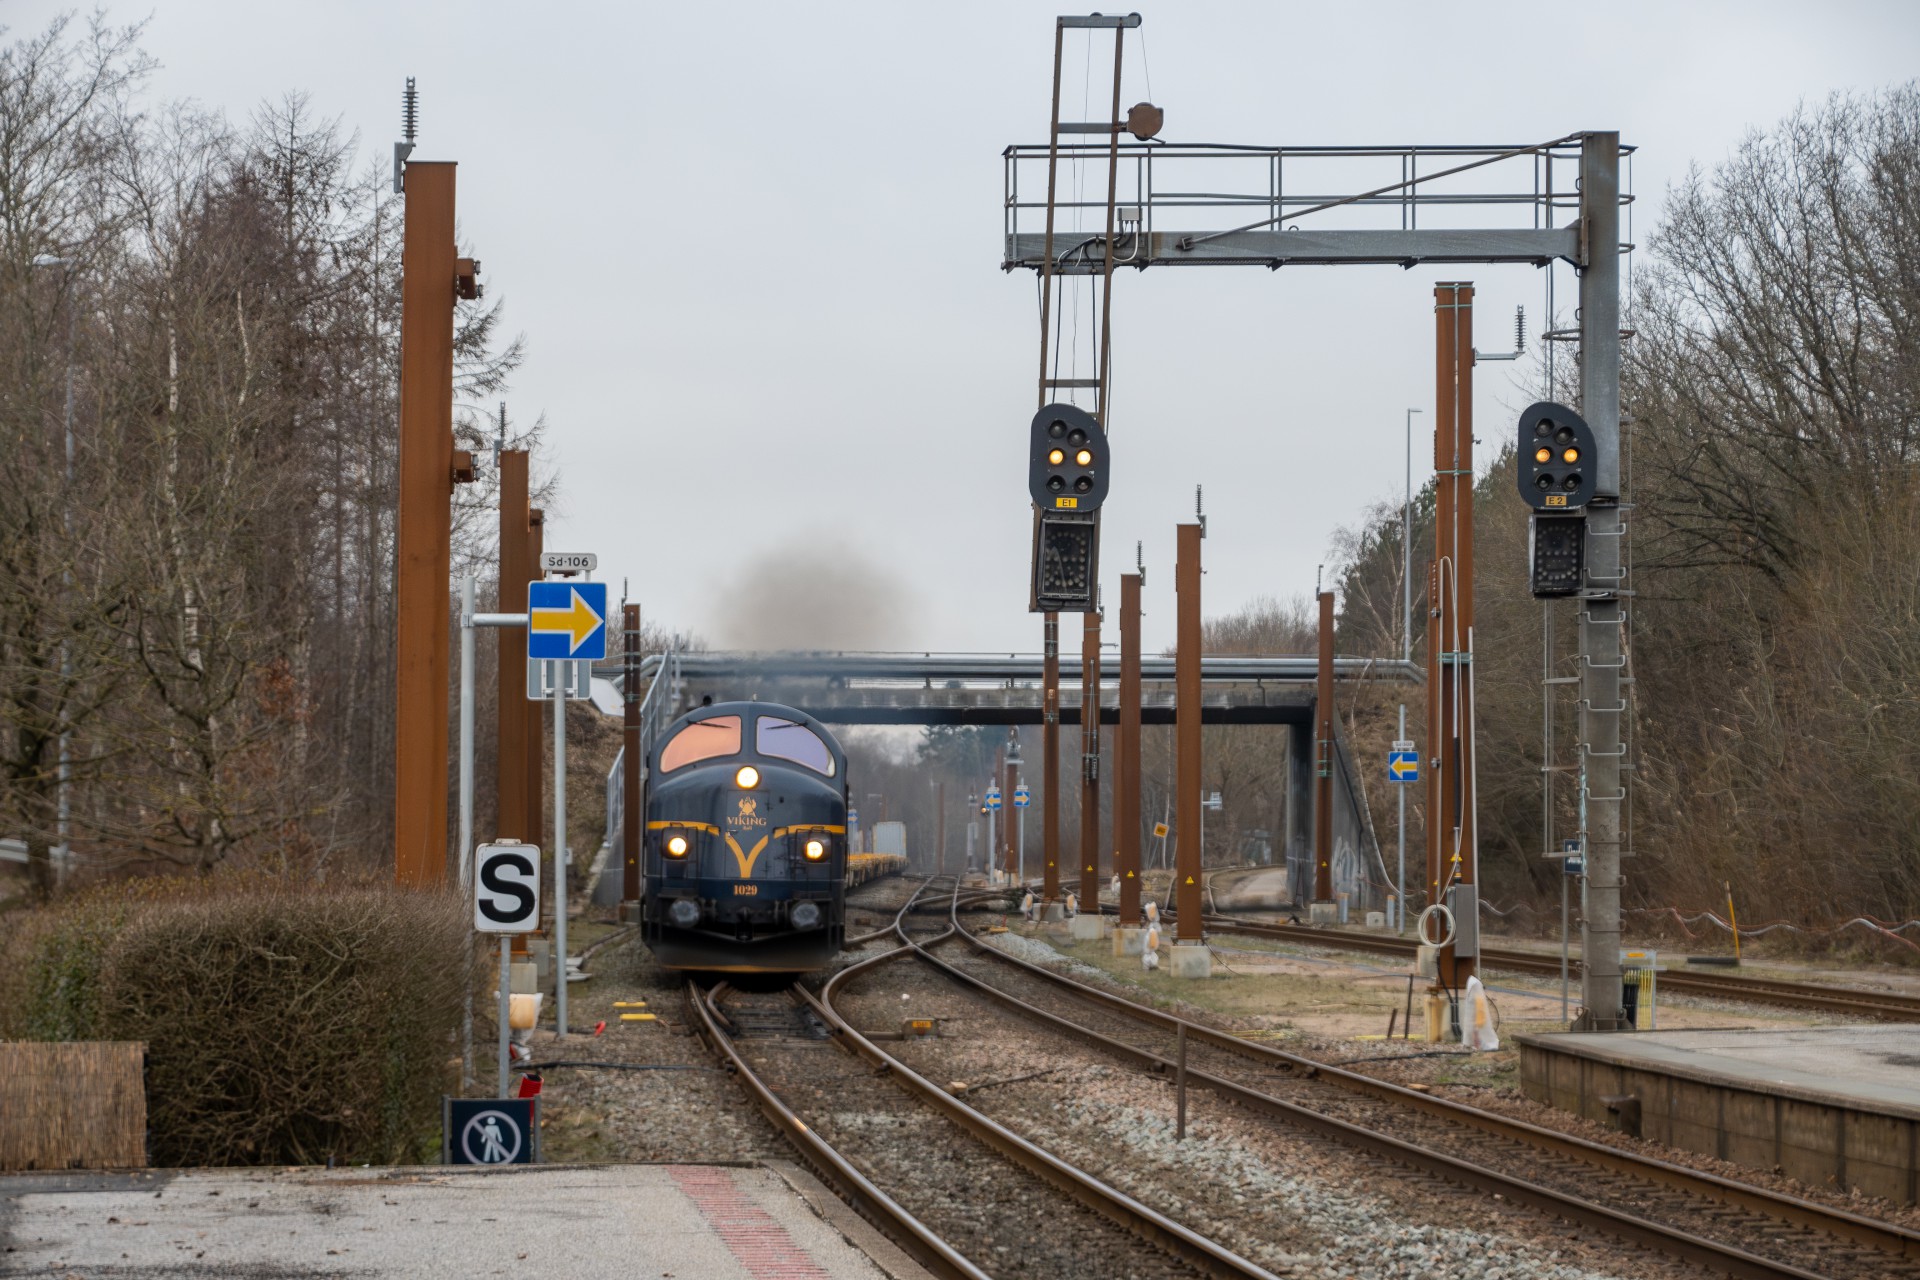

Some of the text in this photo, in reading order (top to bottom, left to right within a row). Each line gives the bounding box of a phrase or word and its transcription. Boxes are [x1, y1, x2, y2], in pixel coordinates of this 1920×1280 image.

[1062, 498, 1071, 507] E1
[727, 816, 767, 826] VIKING
[478, 853, 535, 923] S
[733, 884, 758, 896] 1029
